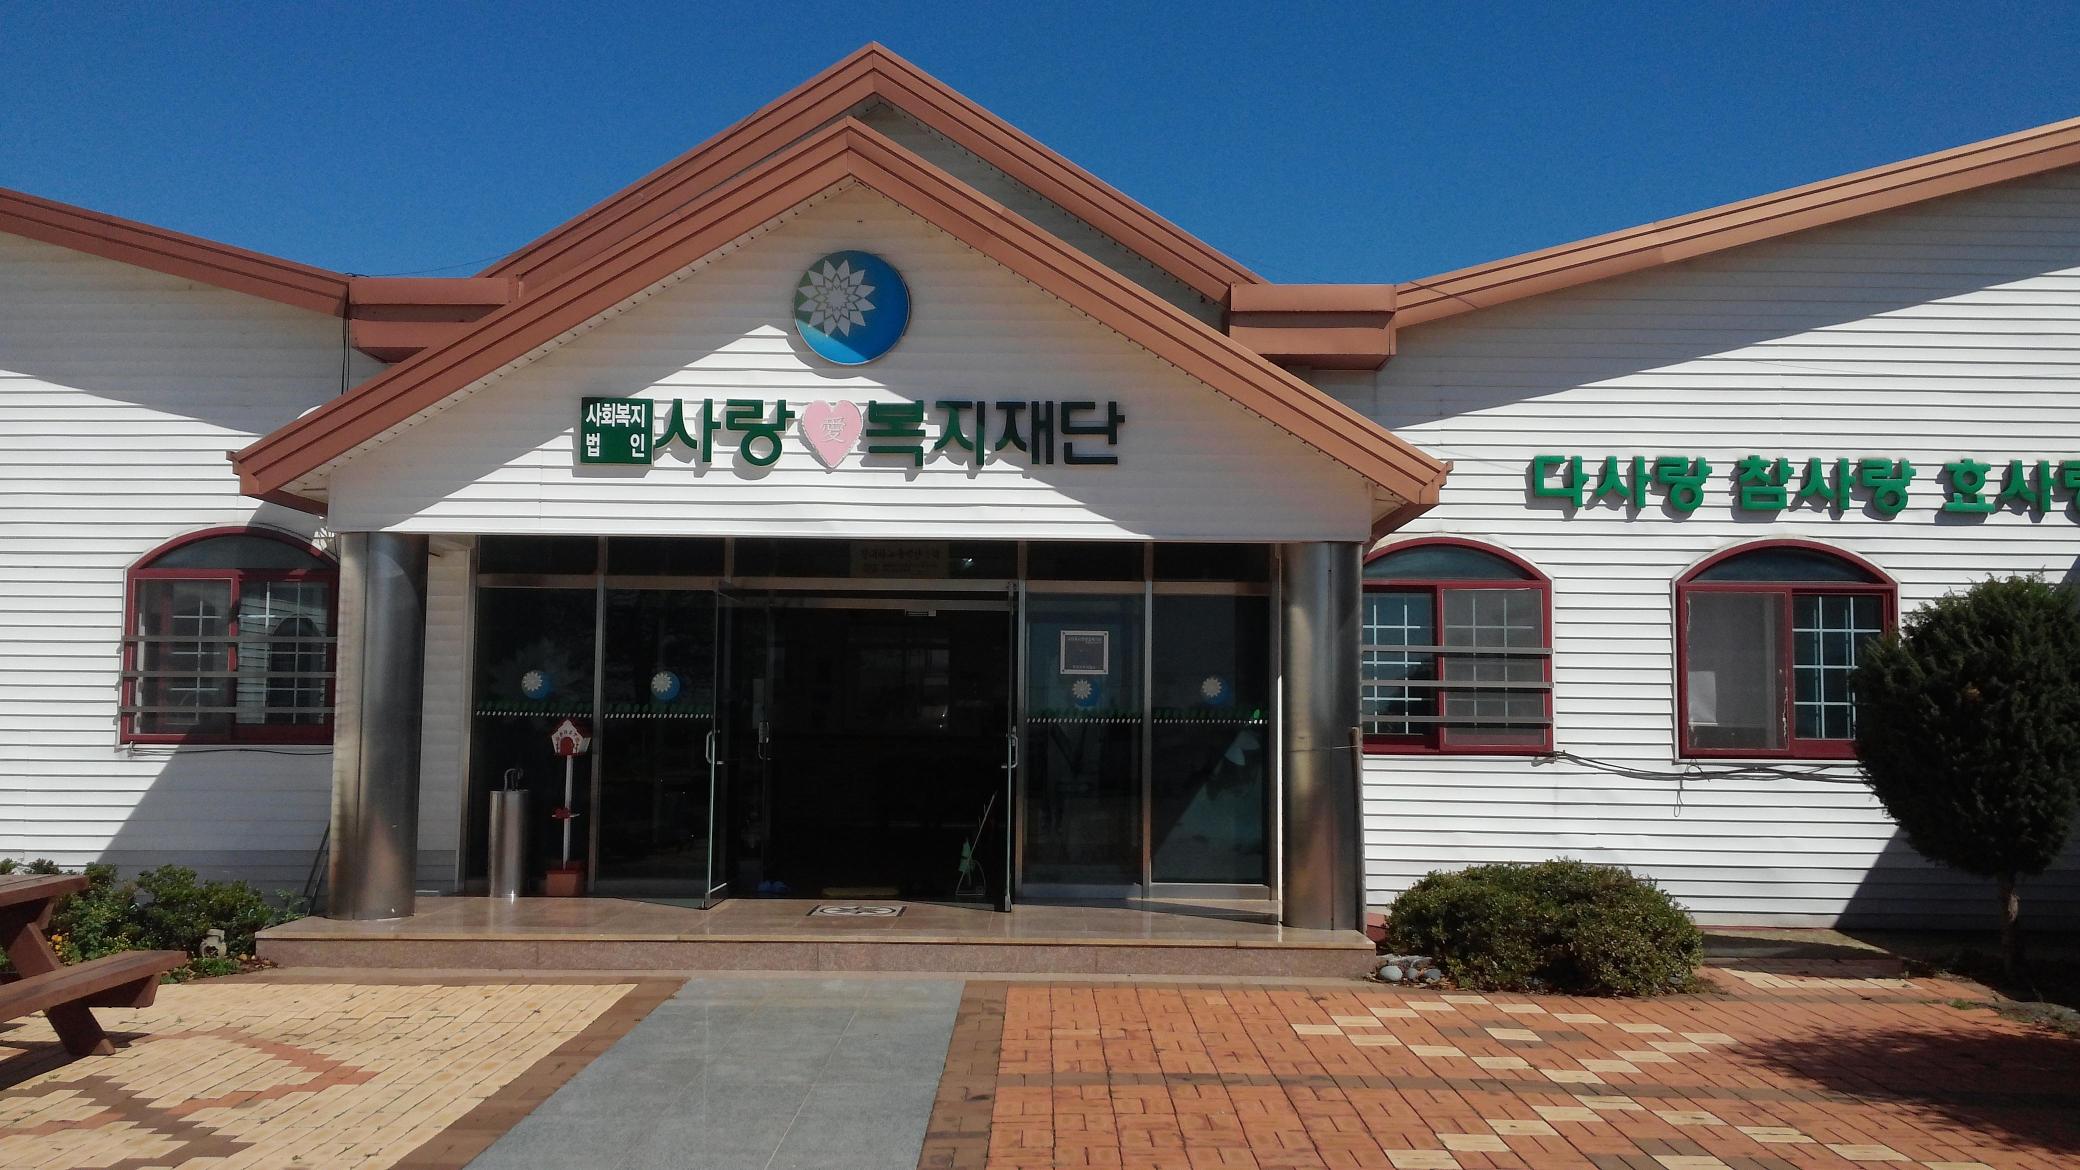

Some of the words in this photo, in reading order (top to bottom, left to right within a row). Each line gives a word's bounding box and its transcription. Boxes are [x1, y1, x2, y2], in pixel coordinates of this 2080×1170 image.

[585, 402, 646, 428] 사회복지
[655, 398, 796, 467] 사랑
[865, 399, 1126, 467] 복지재단
[1533, 455, 1713, 513] 다사랑
[1738, 454, 1917, 515] 참사랑
